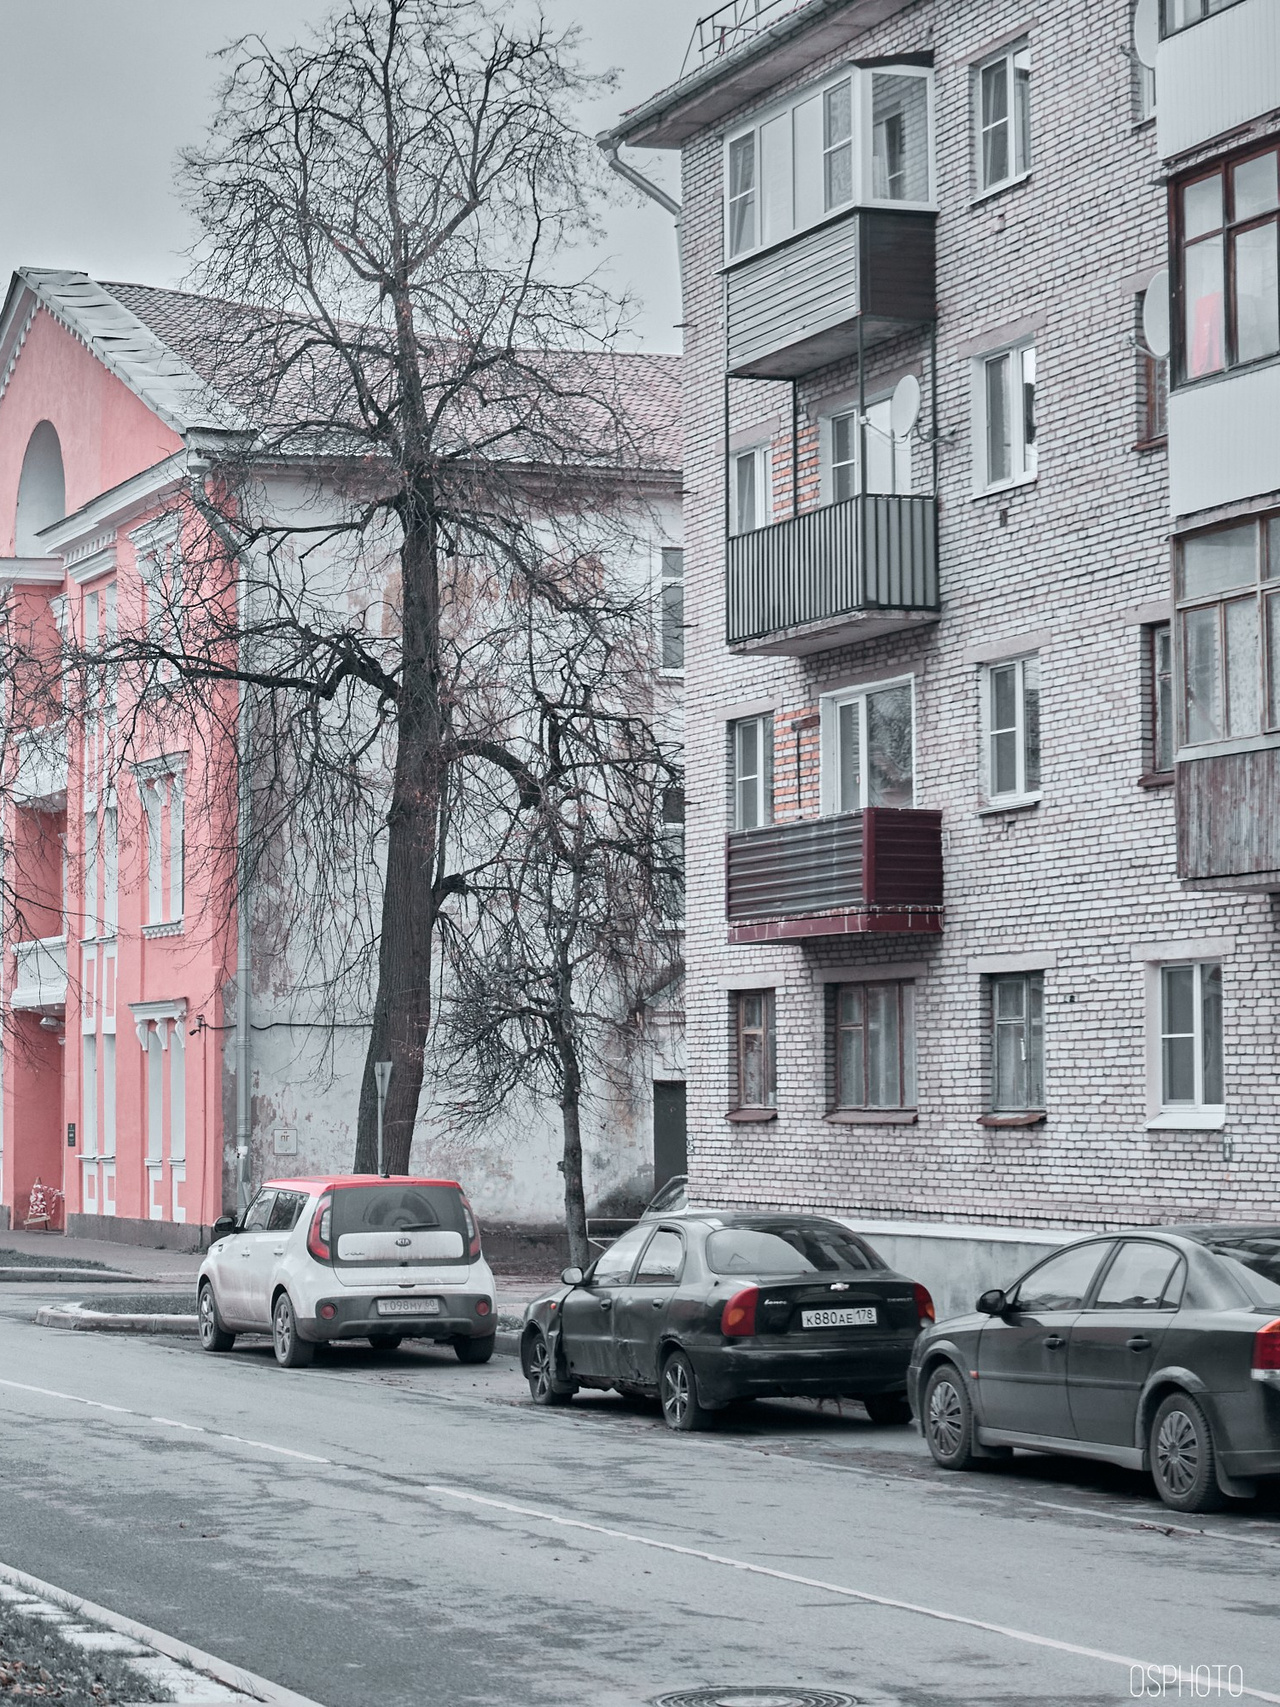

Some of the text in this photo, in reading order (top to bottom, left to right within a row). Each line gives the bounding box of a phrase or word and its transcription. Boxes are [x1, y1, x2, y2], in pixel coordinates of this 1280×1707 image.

[397, 1238, 411, 1246] KIA
[806, 1309, 874, 1326] К880АЕ 178
